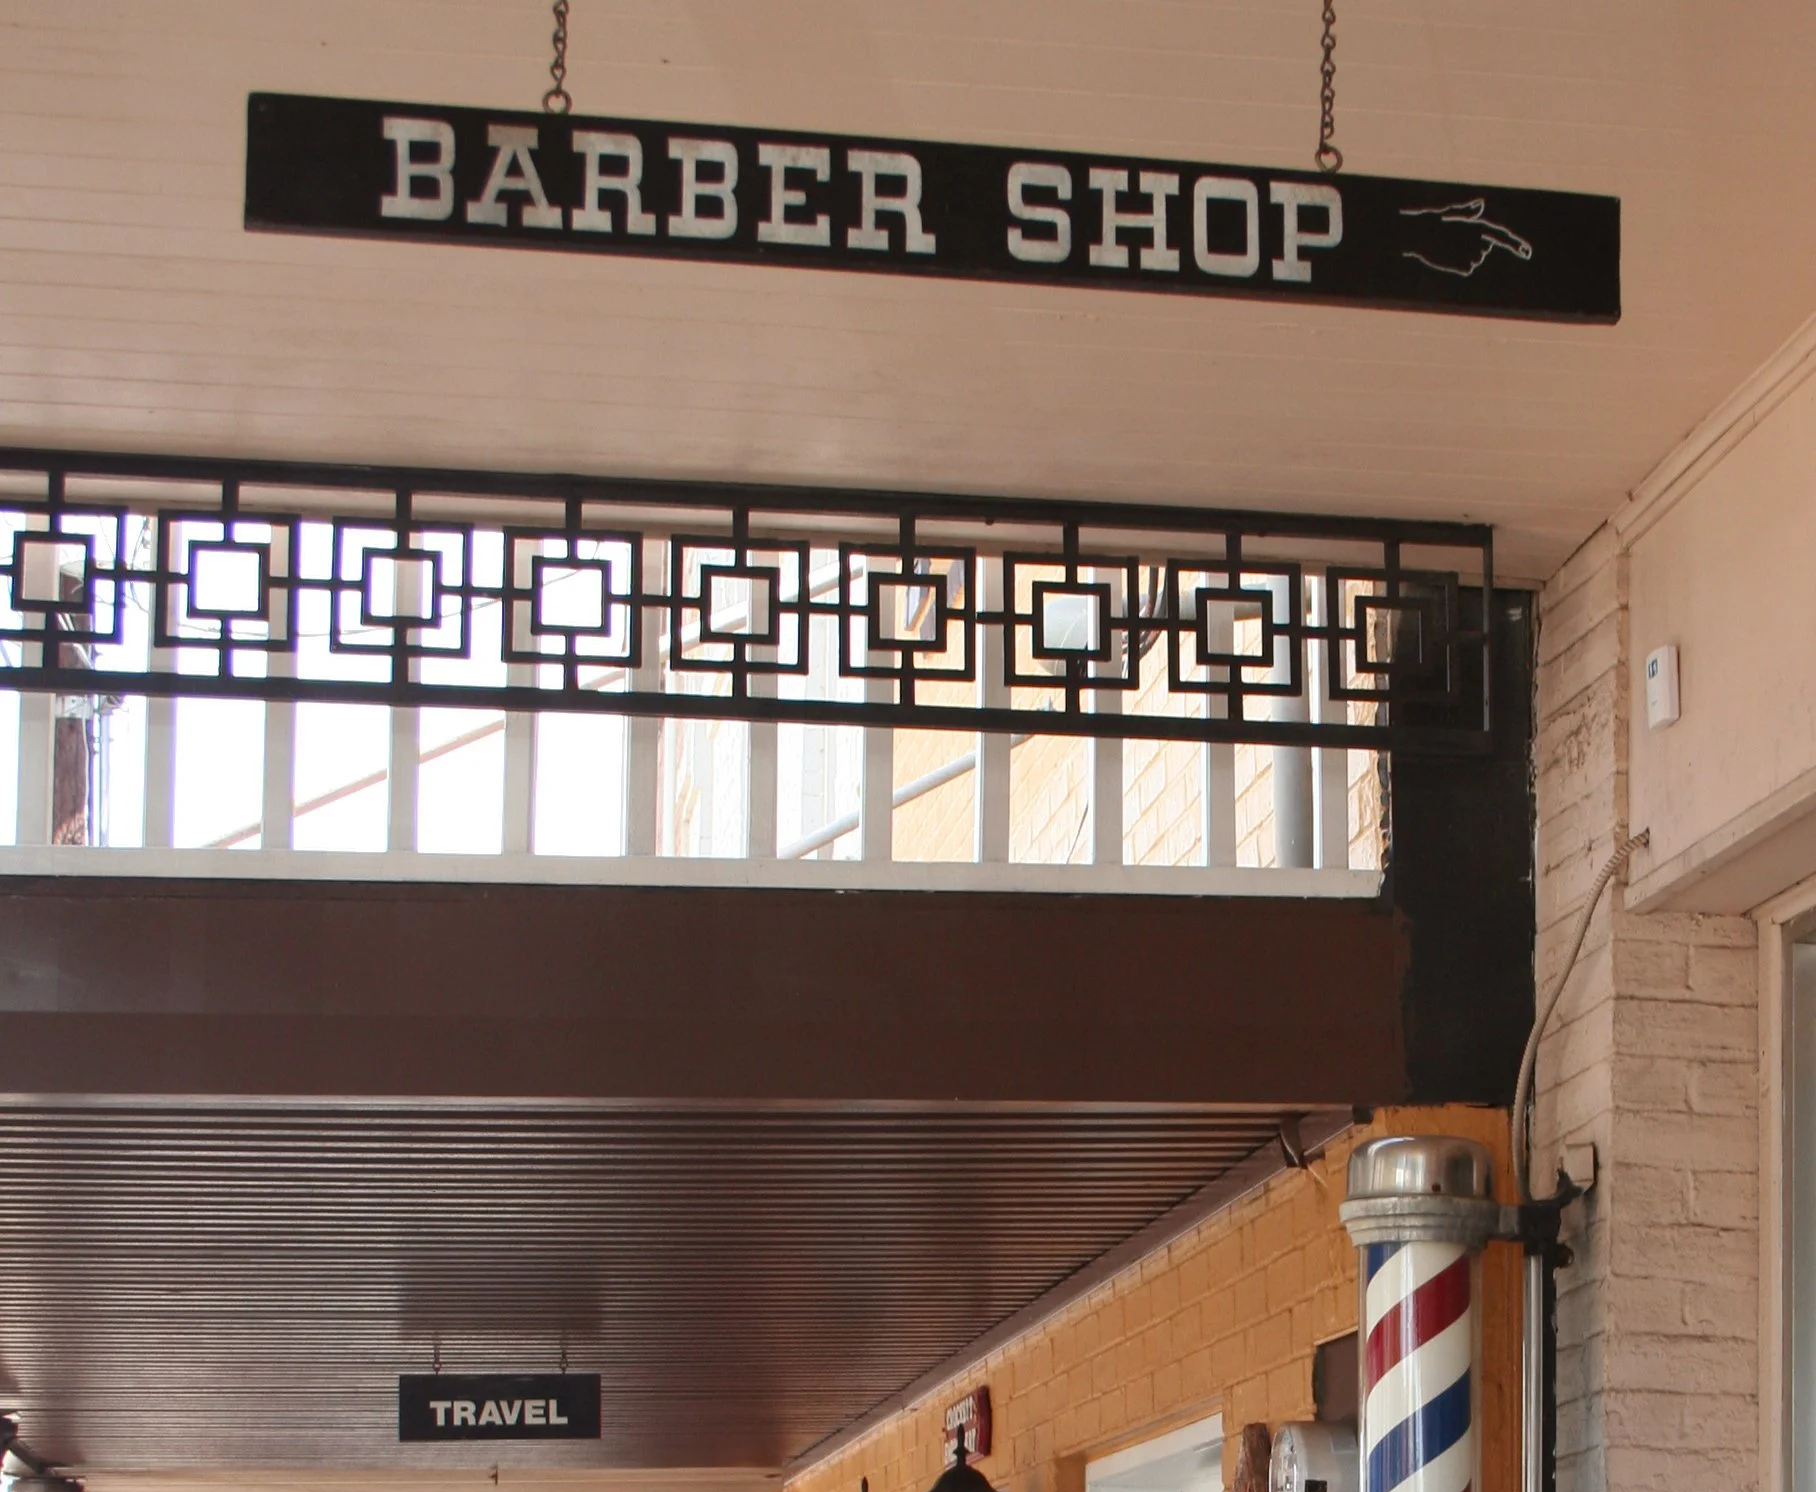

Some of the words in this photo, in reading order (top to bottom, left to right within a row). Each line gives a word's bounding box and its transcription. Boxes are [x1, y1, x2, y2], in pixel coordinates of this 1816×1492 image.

[380, 116, 936, 254] BARBER
[1007, 161, 1343, 283] SHOP
[429, 1399, 569, 1427] TRAVEL
